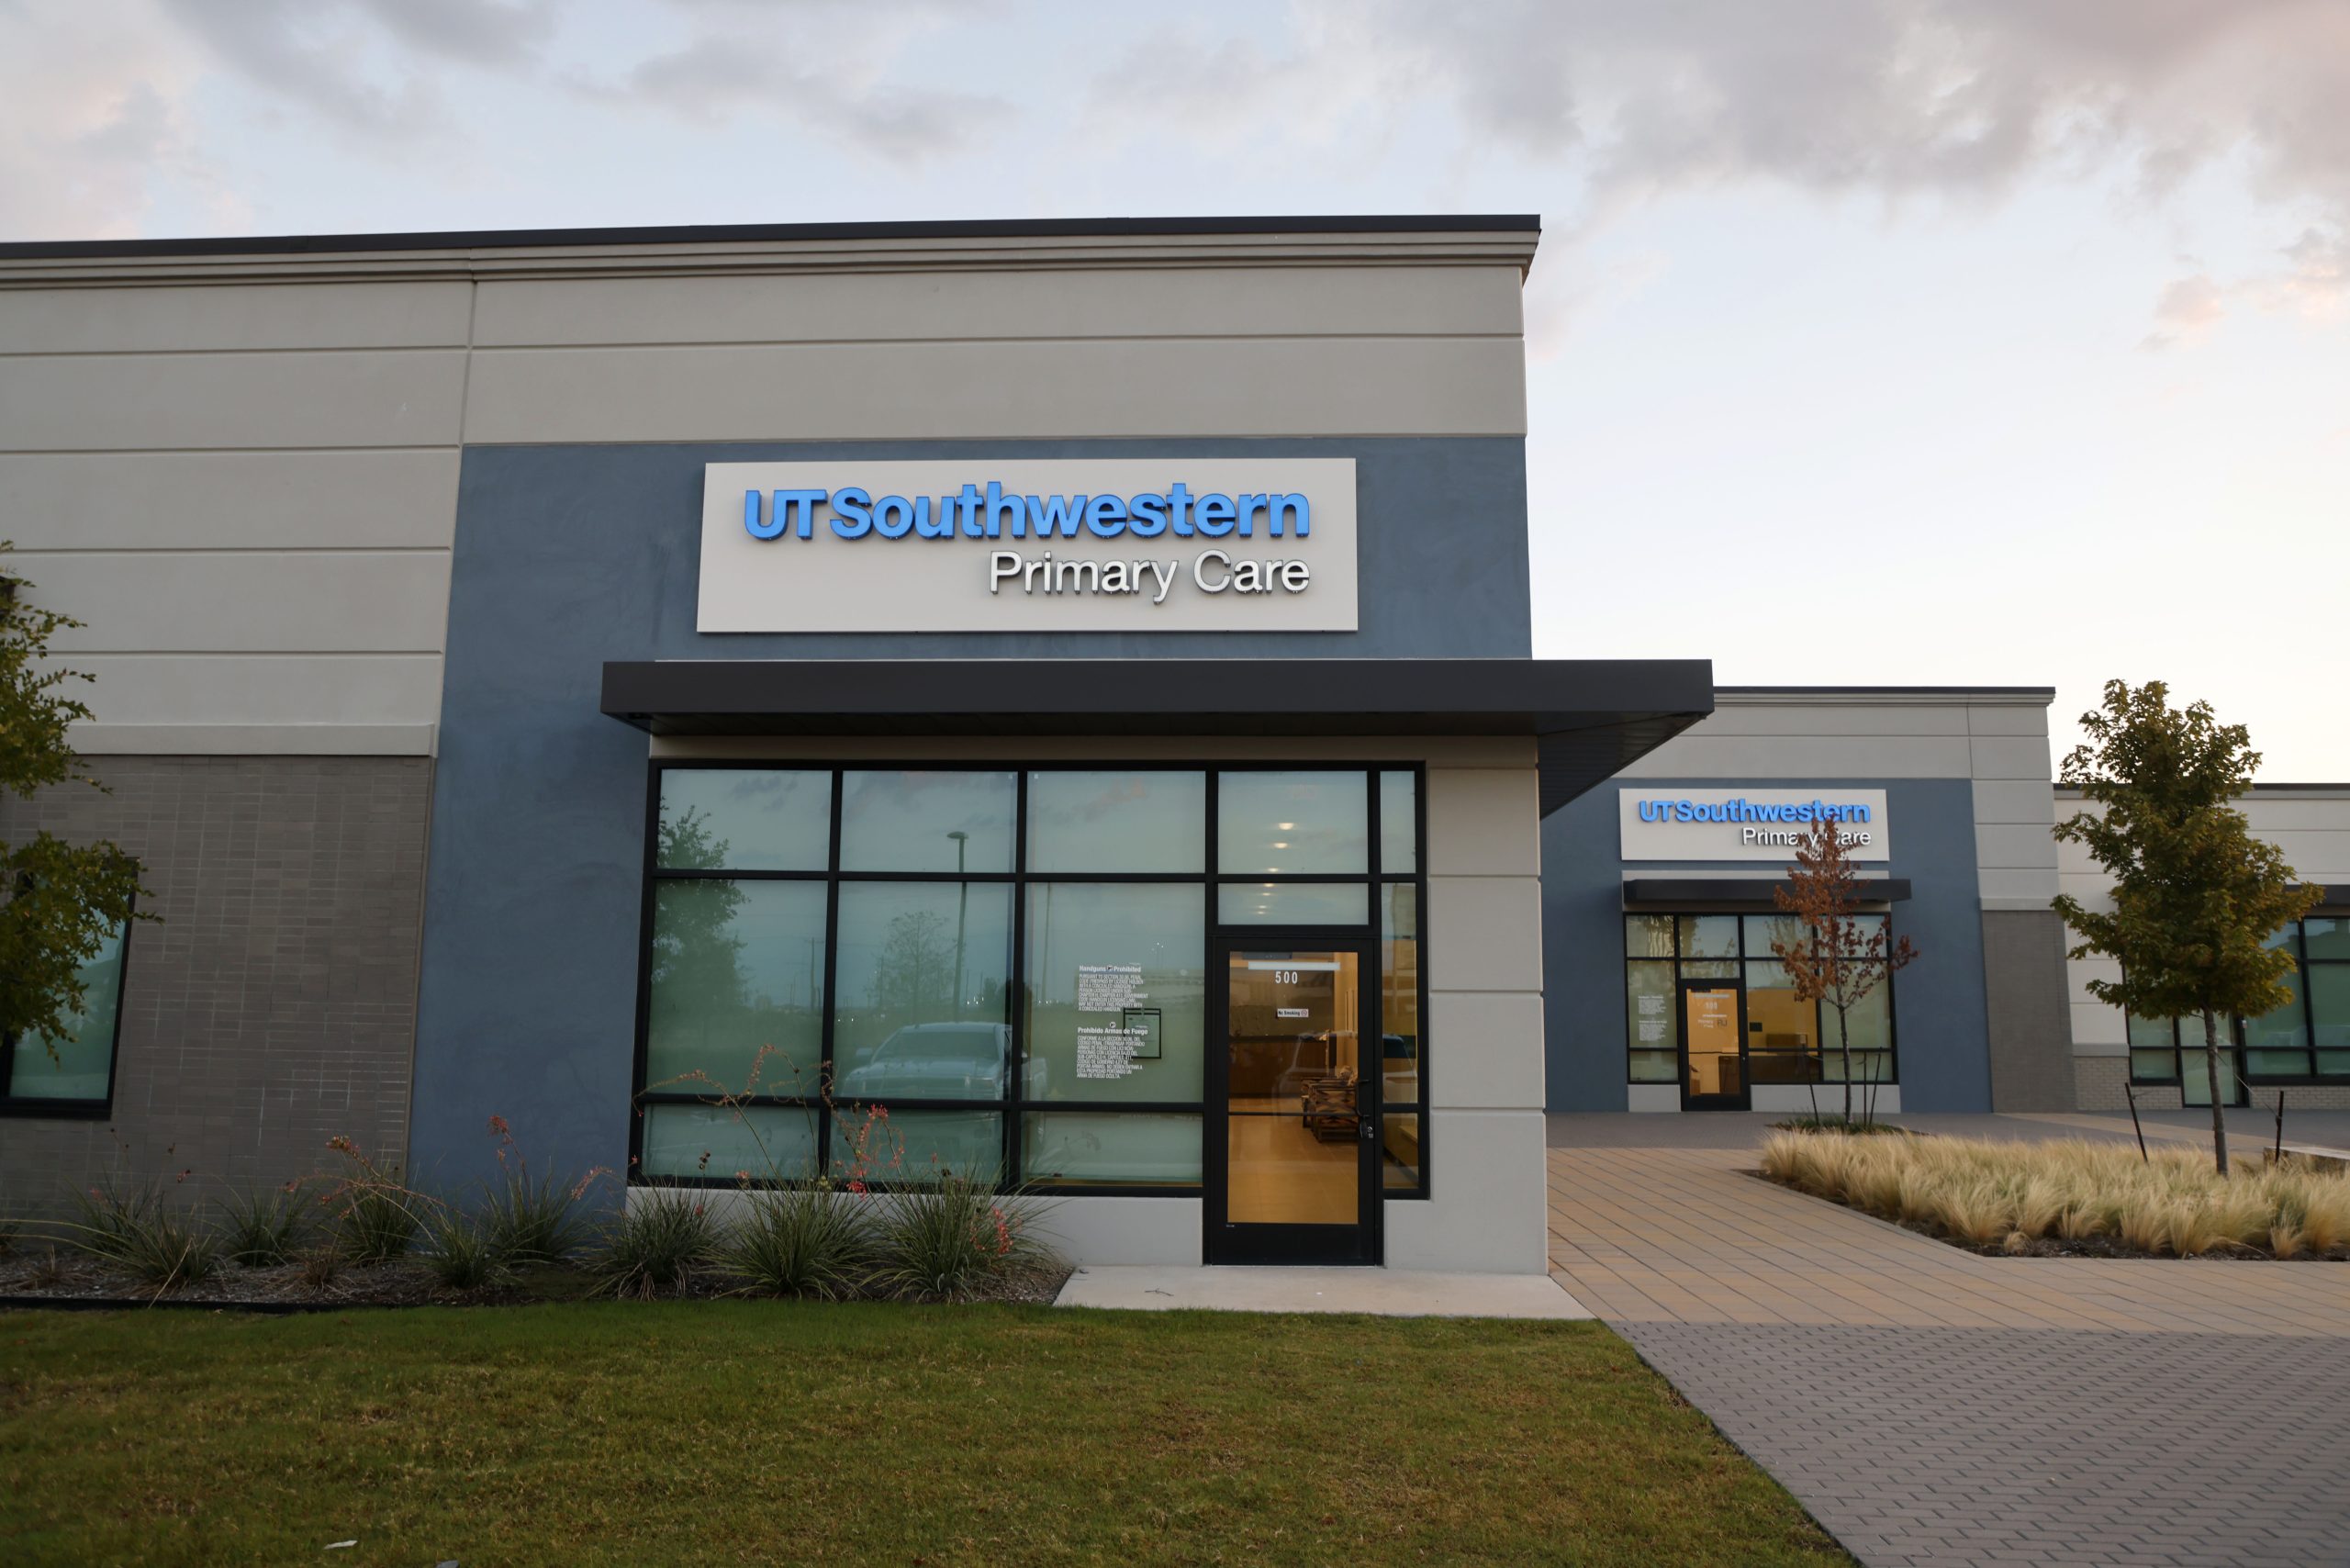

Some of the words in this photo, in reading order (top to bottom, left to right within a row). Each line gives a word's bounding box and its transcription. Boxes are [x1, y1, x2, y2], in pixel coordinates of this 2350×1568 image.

[990, 551, 1180, 605] Primary
[1193, 549, 1311, 595] Care
[1742, 827, 1818, 848] Primay
[1079, 965, 1106, 973] Handguns
[1275, 970, 1298, 984] 500
